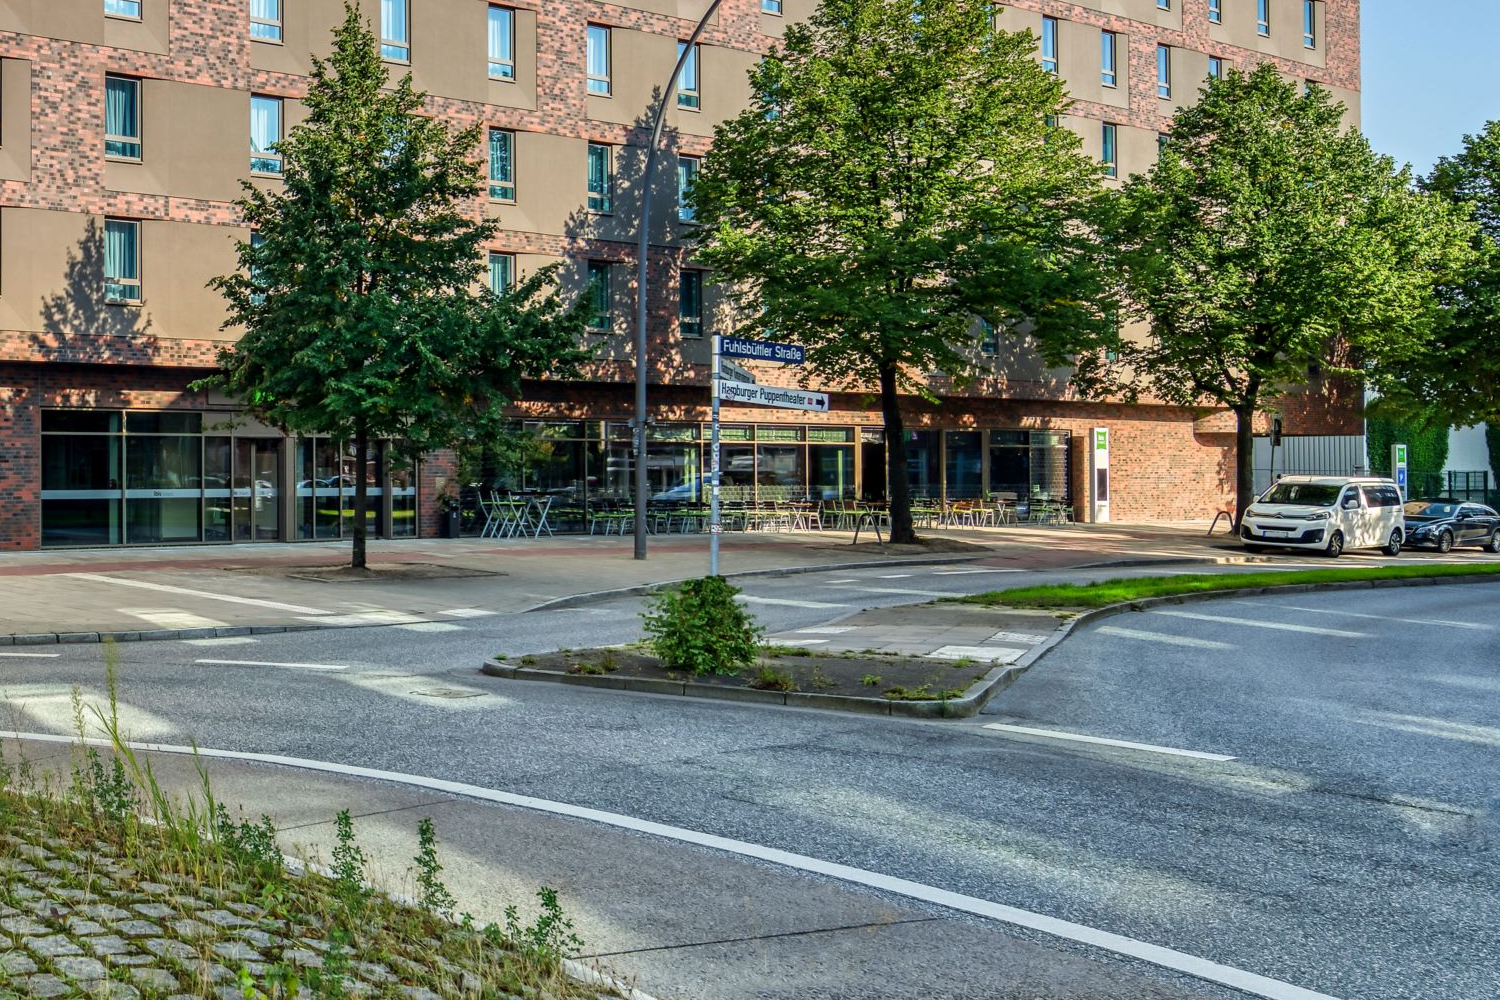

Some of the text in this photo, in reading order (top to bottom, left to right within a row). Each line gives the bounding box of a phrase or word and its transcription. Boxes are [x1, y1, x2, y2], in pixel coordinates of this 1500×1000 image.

[723, 339, 802, 360] Fuhlsbüttler Straße
[721, 382, 806, 405] Hamburger Puppentheater
